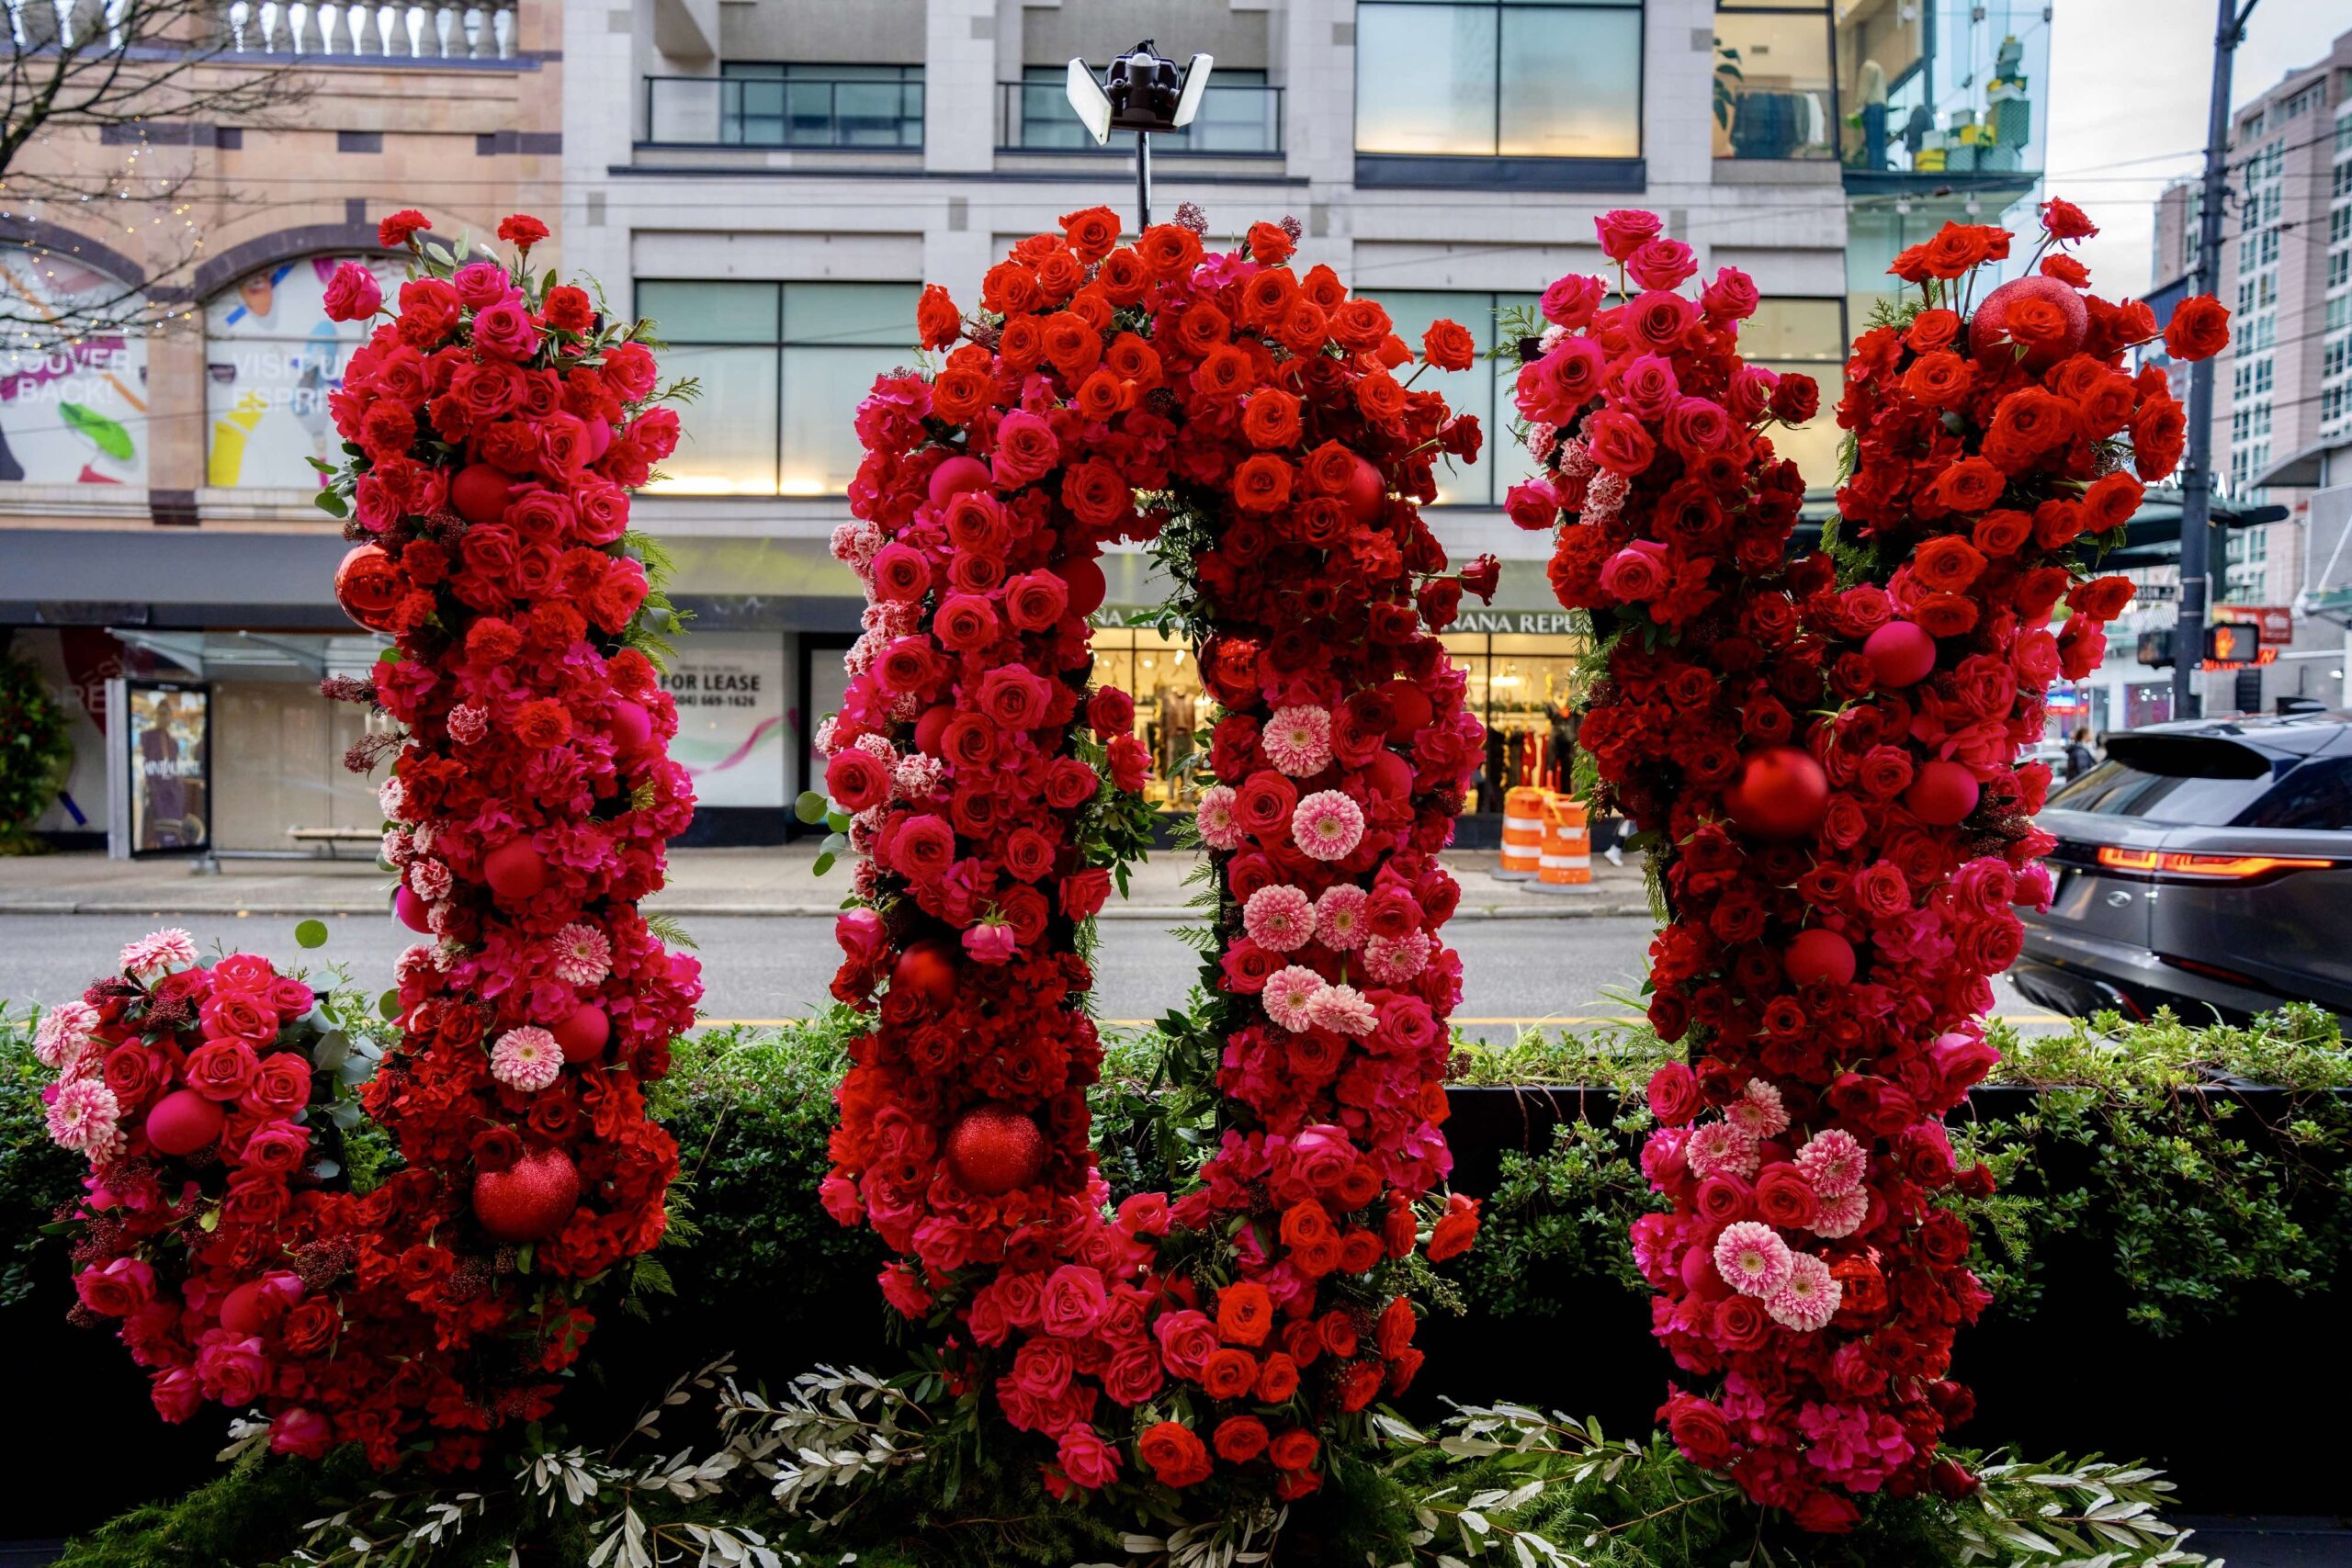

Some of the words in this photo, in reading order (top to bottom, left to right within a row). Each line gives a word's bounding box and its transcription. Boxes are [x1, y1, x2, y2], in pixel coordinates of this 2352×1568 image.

[232, 352, 310, 379] VISIT
[233, 386, 327, 413] ESPRI
[661, 673, 696, 690] FOR
[704, 674, 761, 692] LEASE
[701, 694, 756, 707] 669-1626
